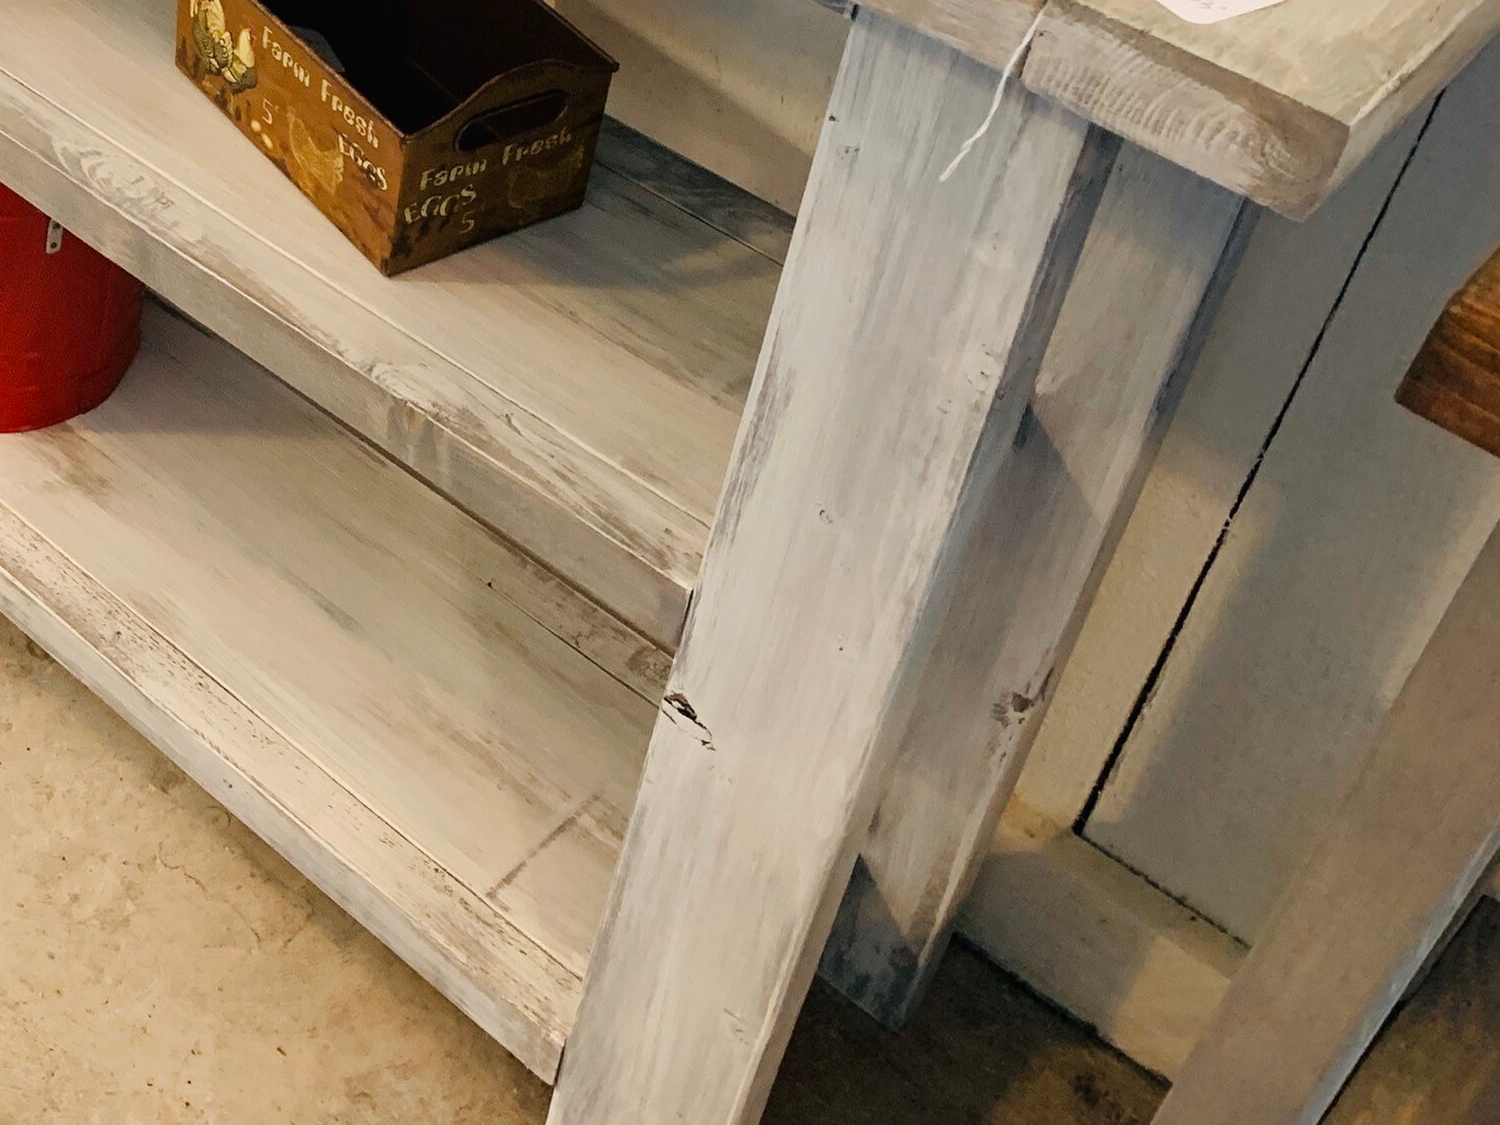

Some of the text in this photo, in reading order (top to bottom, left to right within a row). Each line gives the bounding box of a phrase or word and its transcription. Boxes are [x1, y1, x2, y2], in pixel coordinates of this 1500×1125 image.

[262, 25, 379, 149] Farm Fresh
[337, 132, 388, 191] EGGS
[419, 126, 572, 191] Farm Fresh
[403, 183, 477, 225] EGGS
